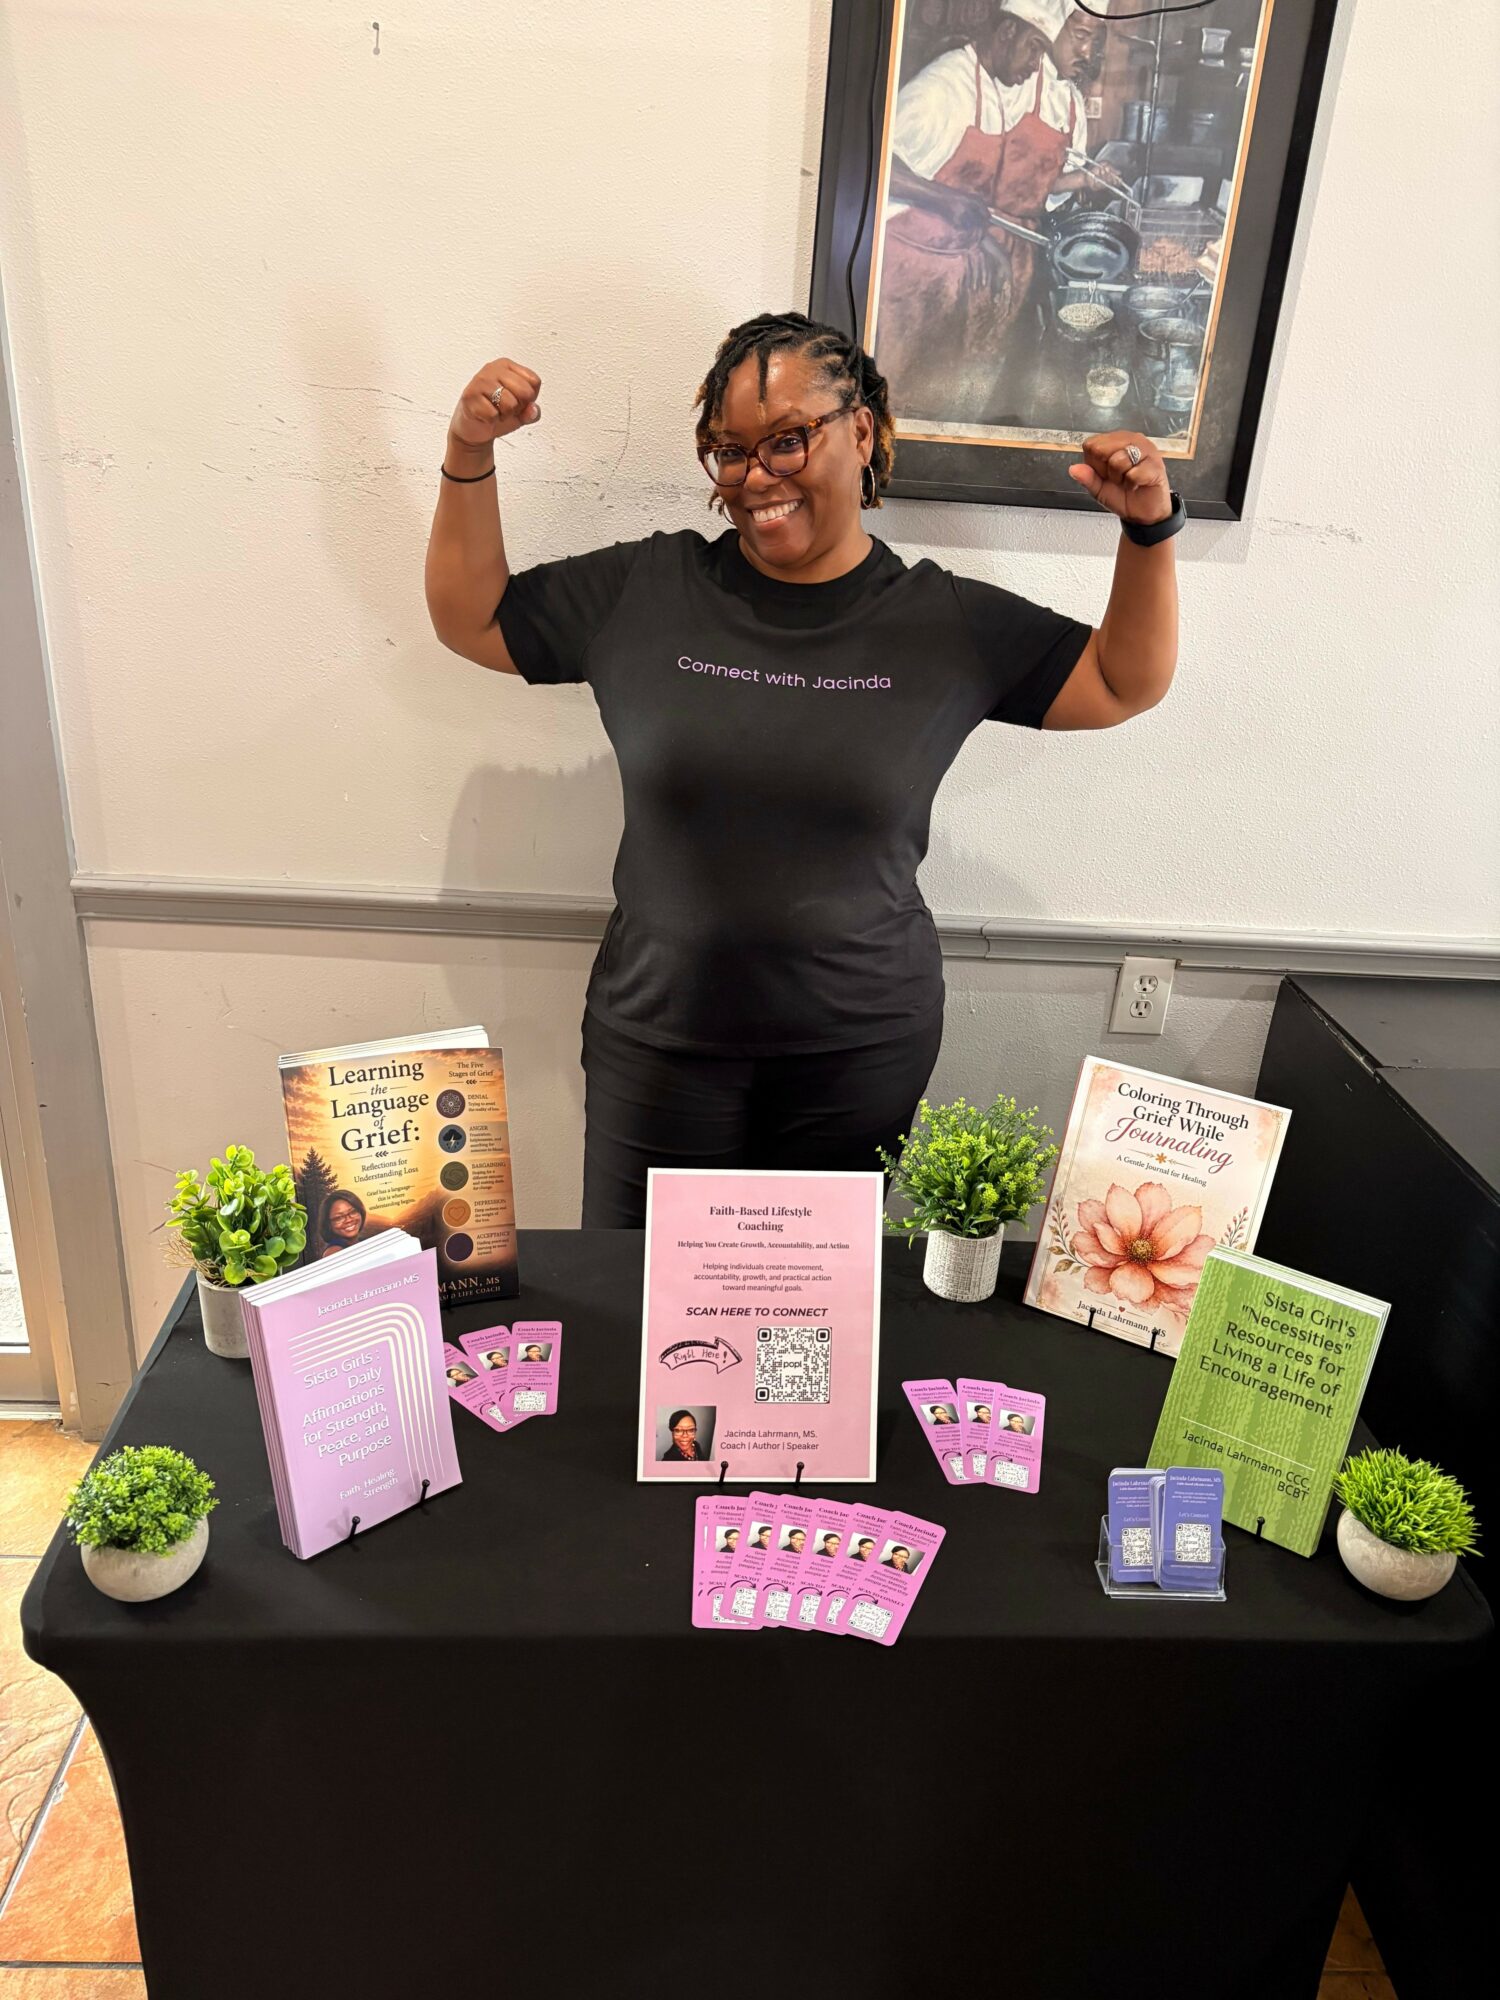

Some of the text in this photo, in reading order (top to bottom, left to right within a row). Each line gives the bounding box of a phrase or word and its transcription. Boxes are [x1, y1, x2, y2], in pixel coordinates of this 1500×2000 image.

[678, 656, 892, 690] Connect with Jacinda
[328, 1060, 424, 1086] Learning
[449, 1069, 494, 1078] Stages of Grief
[457, 1061, 469, 1069] The
[370, 1084, 388, 1096] the
[331, 1093, 429, 1118] Language
[1118, 1082, 1249, 1130] Coloring Through
[373, 1116, 386, 1130] of
[1133, 1106, 1225, 1141] Grief While
[341, 1119, 420, 1152] Grief:
[1105, 1117, 1234, 1174] Journaling
[354, 1169, 403, 1183] Understanding
[361, 1158, 408, 1172] Reflections for
[472, 1161, 506, 1169] BARGAINING
[1123, 1156, 1146, 1168] Gentle
[1145, 1164, 1170, 1176] Journal
[1170, 1168, 1181, 1178] for
[1181, 1172, 1207, 1187] Healing
[709, 1206, 813, 1219] Faith-Based Lifestyle
[737, 1221, 784, 1233] Coaching
[677, 1240, 703, 1249] Helping
[740, 1241, 766, 1249] Growth,
[767, 1241, 815, 1250] Accountability,
[693, 1273, 741, 1282] accountability,
[742, 1274, 768, 1282] growth,
[782, 1274, 811, 1282] practical
[703, 1263, 728, 1271] Helping
[729, 1263, 764, 1271] individuals
[787, 1264, 824, 1272] movement,
[486, 1276, 500, 1285] MS
[747, 1284, 784, 1292] meaningful
[317, 1273, 420, 1318] Jacinda Lahrmann MS
[686, 1307, 829, 1317] SCAN HERE TO CONNECT
[1077, 1300, 1106, 1316] Jacda
[1107, 1311, 1151, 1333] Lahrmann,
[1263, 1291, 1357, 1338] Sista Girl's
[1242, 1304, 1352, 1355] "Necessities"
[1225, 1321, 1346, 1377] Resources for
[303, 1366, 339, 1389] Sista
[341, 1352, 374, 1373] Girls
[783, 1361, 802, 1369] popl
[1212, 1338, 1342, 1398] Living a Life of
[347, 1366, 382, 1390] Daily
[1199, 1355, 1334, 1419] Encouragement
[302, 1384, 385, 1428] Affirmations
[303, 1401, 387, 1447] for Strength,
[724, 1430, 756, 1438] Jacinda
[758, 1430, 801, 1439] Lahrmann,
[318, 1416, 390, 1458] Peace, and
[720, 1442, 819, 1451] Coach Author Speaker
[338, 1434, 393, 1467] Purpose
[1182, 1430, 1310, 1491] Jacinda Lahrmann CCC,
[363, 1477, 399, 1500] Strength
[1276, 1480, 1310, 1501] BCBT
[894, 1519, 914, 1530] Coach
